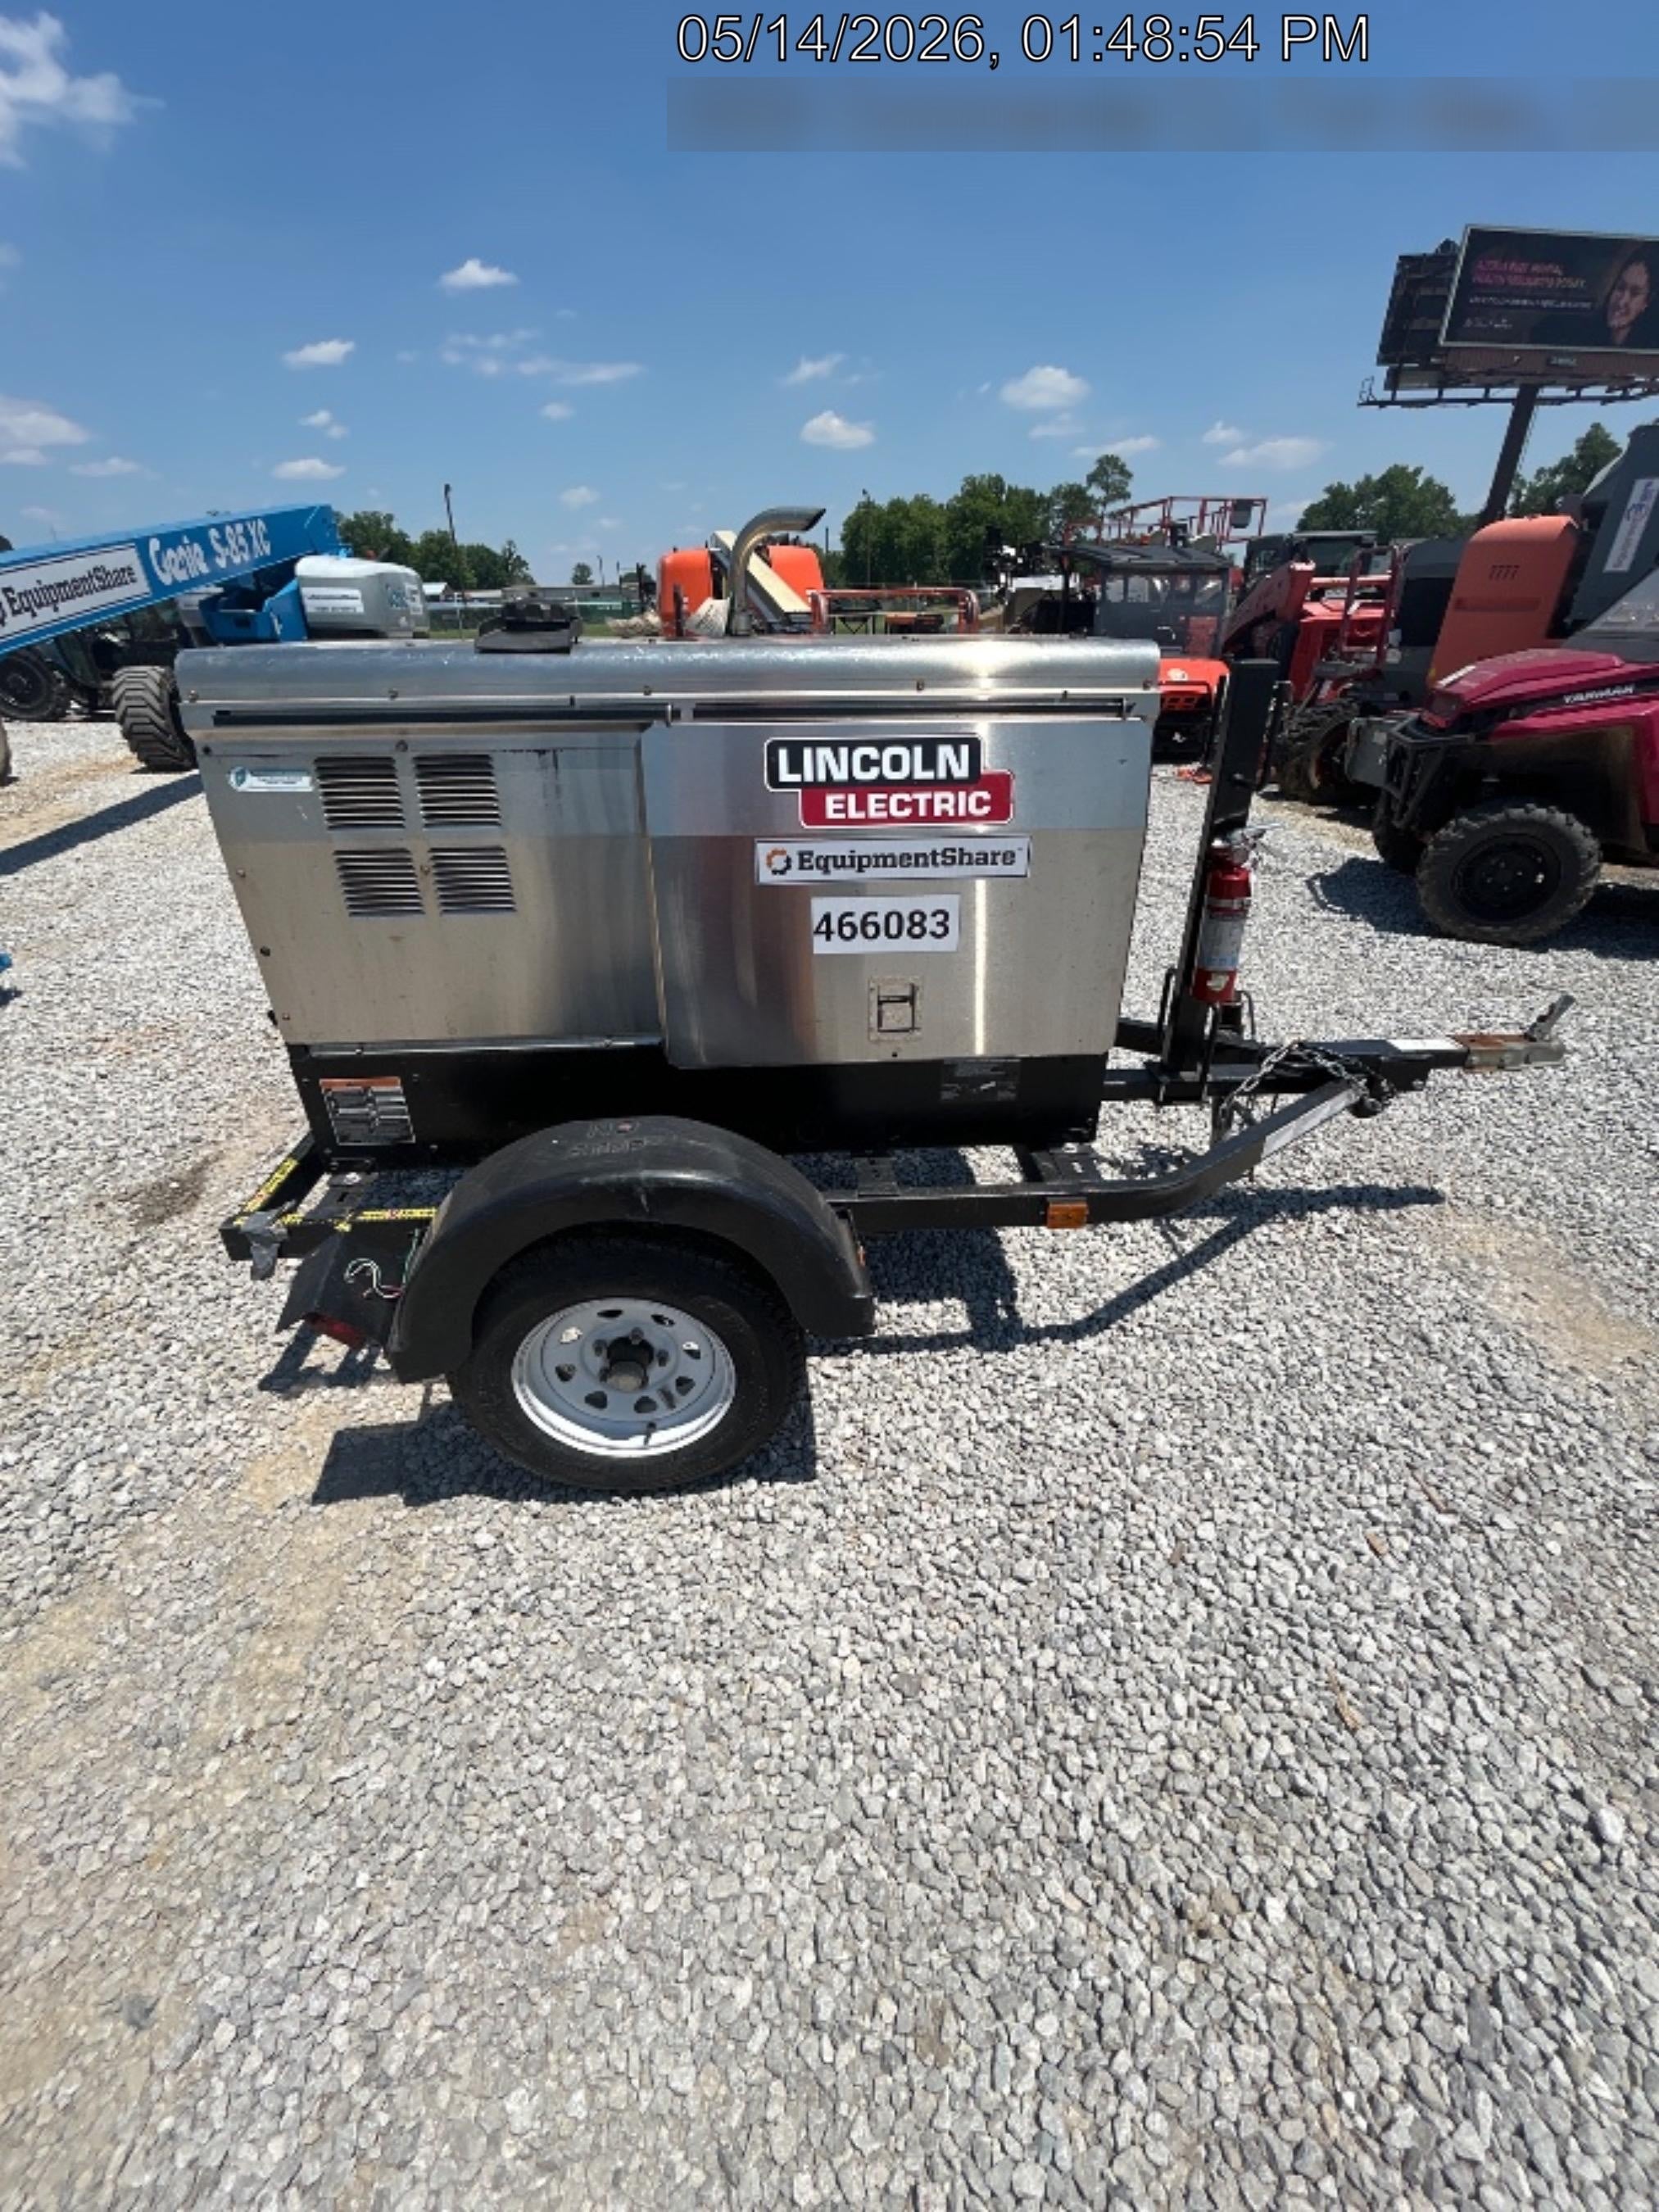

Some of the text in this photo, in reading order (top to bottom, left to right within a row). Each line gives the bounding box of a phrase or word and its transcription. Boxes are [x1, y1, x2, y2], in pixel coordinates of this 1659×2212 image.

[3, 565, 137, 619] EquipmentShare
[777, 744, 970, 782] LINCOLN
[824, 791, 992, 819] ELECTRIC
[797, 847, 1017, 874] EquipmentShare
[814, 909, 951, 941] 466083
